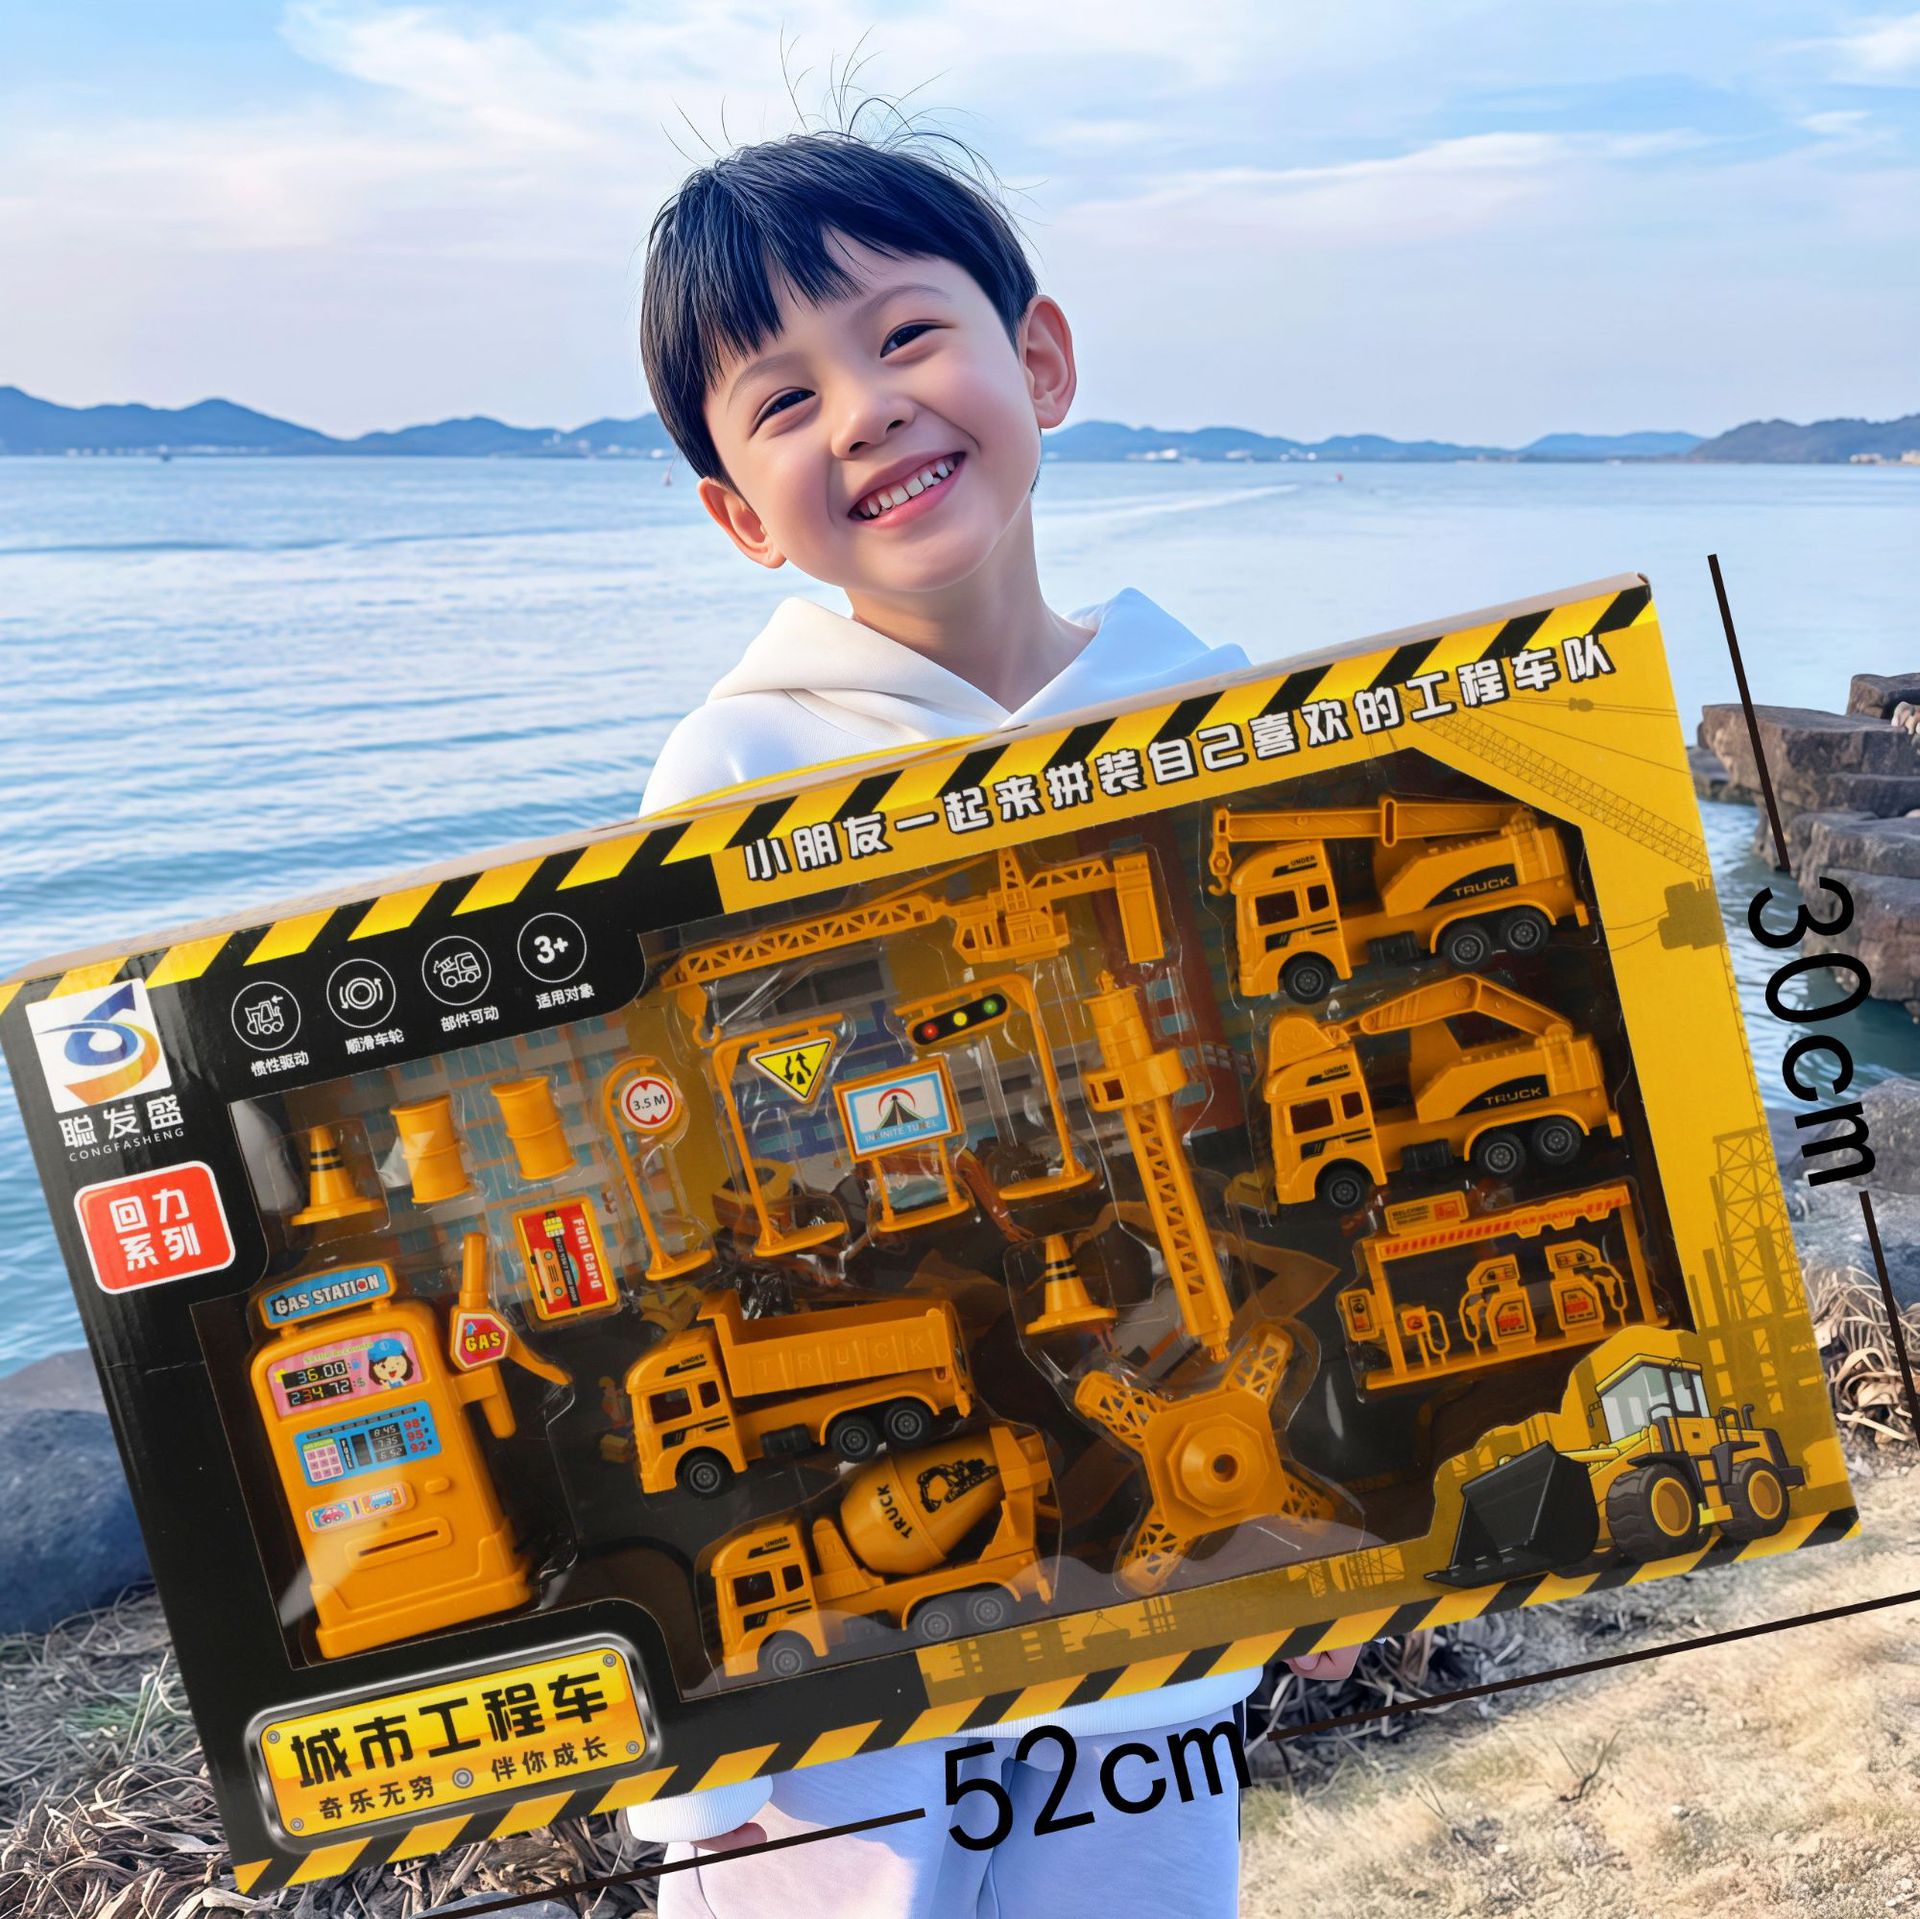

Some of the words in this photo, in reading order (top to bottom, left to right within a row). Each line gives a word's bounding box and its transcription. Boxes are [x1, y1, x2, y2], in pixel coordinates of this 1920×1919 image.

[744, 633, 1615, 882] 小朋友一起来拼装自己喜欢的工程车队
[1290, 854, 1316, 866] UNDER
[1452, 875, 1512, 898] TRUCK
[534, 936, 569, 964] 3+
[535, 983, 595, 1010] 适用对象
[440, 1006, 500, 1032] 部件可动
[345, 1029, 405, 1055] 顺滑车轮
[251, 1051, 310, 1077] 惯性驱动
[1323, 1063, 1349, 1076] UNDER
[1484, 1086, 1543, 1107] TRUCK
[58, 1094, 184, 1149] 聪发盛
[69, 1127, 185, 1162] CONGFASHENG
[109, 1188, 190, 1234] 回力
[119, 1222, 202, 1272] 系列
[573, 1217, 592, 1250] Fuel
[582, 1252, 602, 1290] Card
[274, 1293, 311, 1316] GAS
[311, 1274, 380, 1305] STATION
[465, 1331, 501, 1352] GAS
[680, 1353, 706, 1366] UNDER
[757, 1336, 926, 1377] TRUCK
[297, 1361, 347, 1384] 36.00
[876, 1484, 914, 1540] TRUCK
[764, 1535, 789, 1548] UNDER
[290, 1671, 609, 1789] 城市工程车
[318, 1775, 436, 1821] 奇乐无穷
[490, 1737, 609, 1782] 伴你成长
